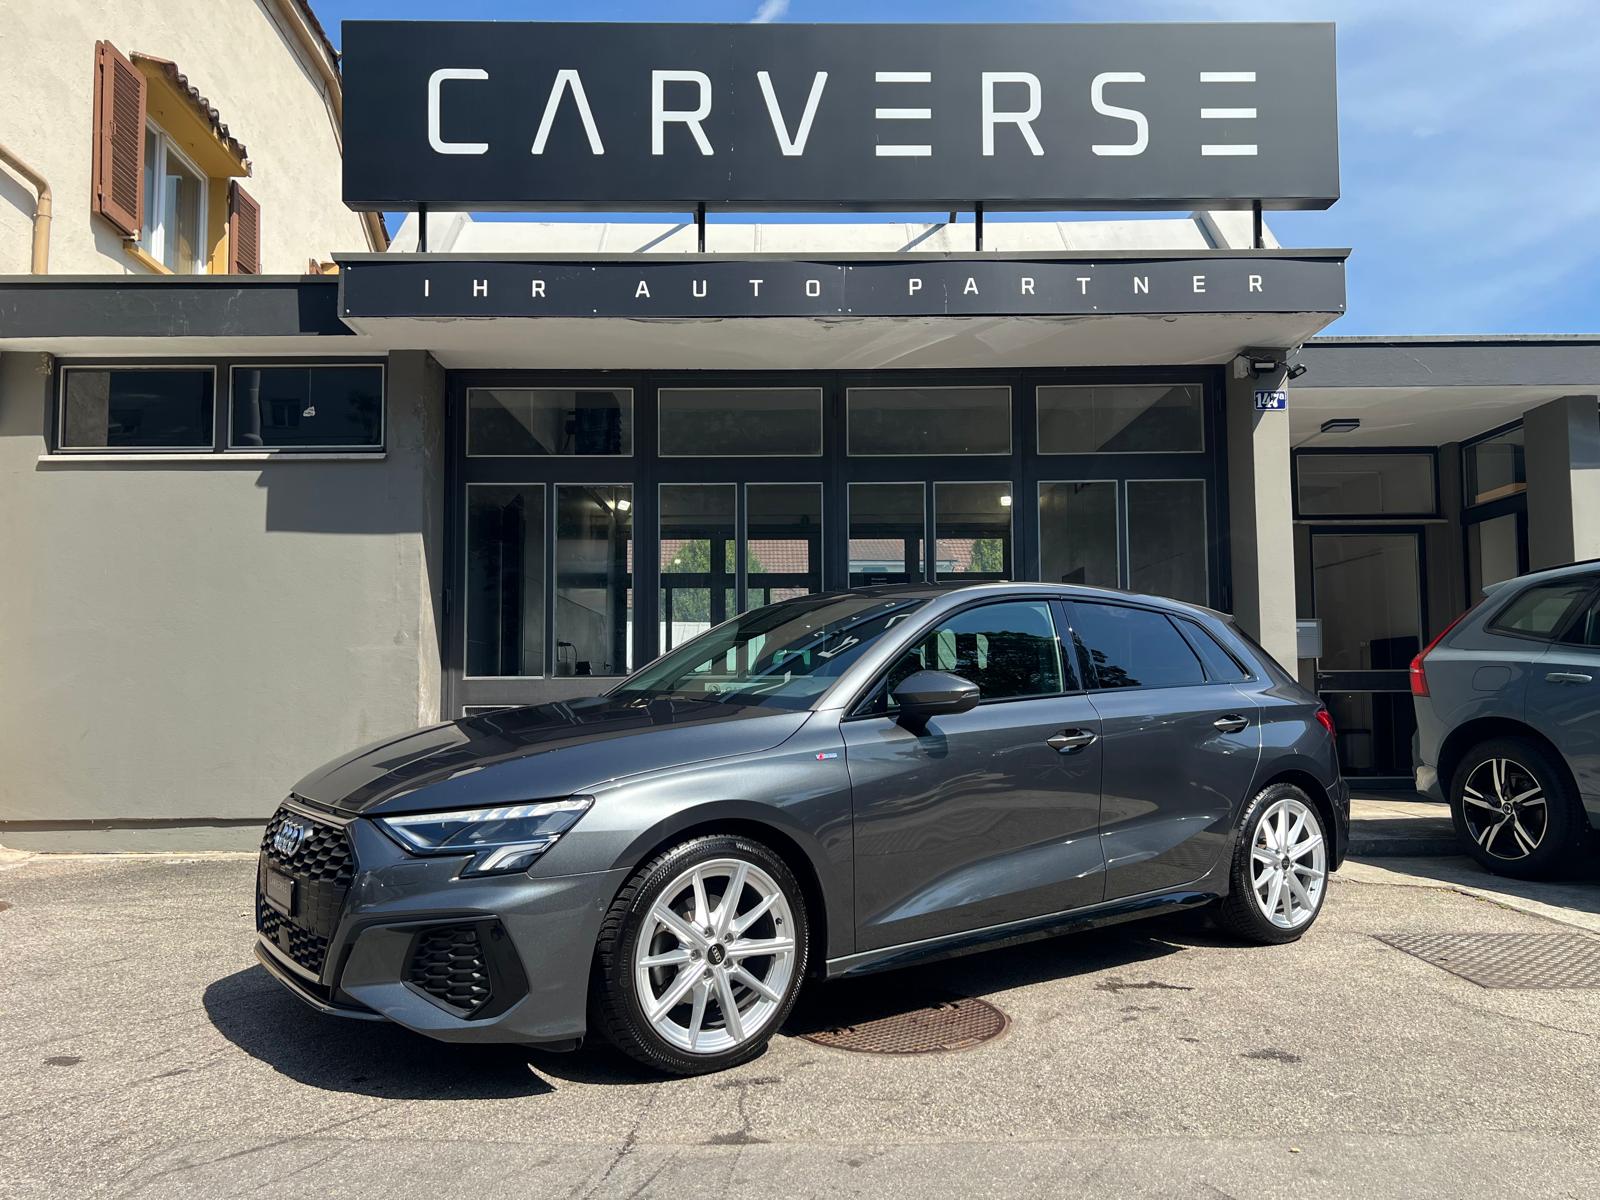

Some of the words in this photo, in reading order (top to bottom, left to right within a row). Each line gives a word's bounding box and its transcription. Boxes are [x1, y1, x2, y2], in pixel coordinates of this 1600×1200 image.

[427, 68, 1259, 157] CARVERSE
[424, 279, 546, 298] IHR
[635, 279, 821, 298] AUTO
[909, 274, 1263, 297] PARTNER
[1255, 392, 1285, 408] 147a
